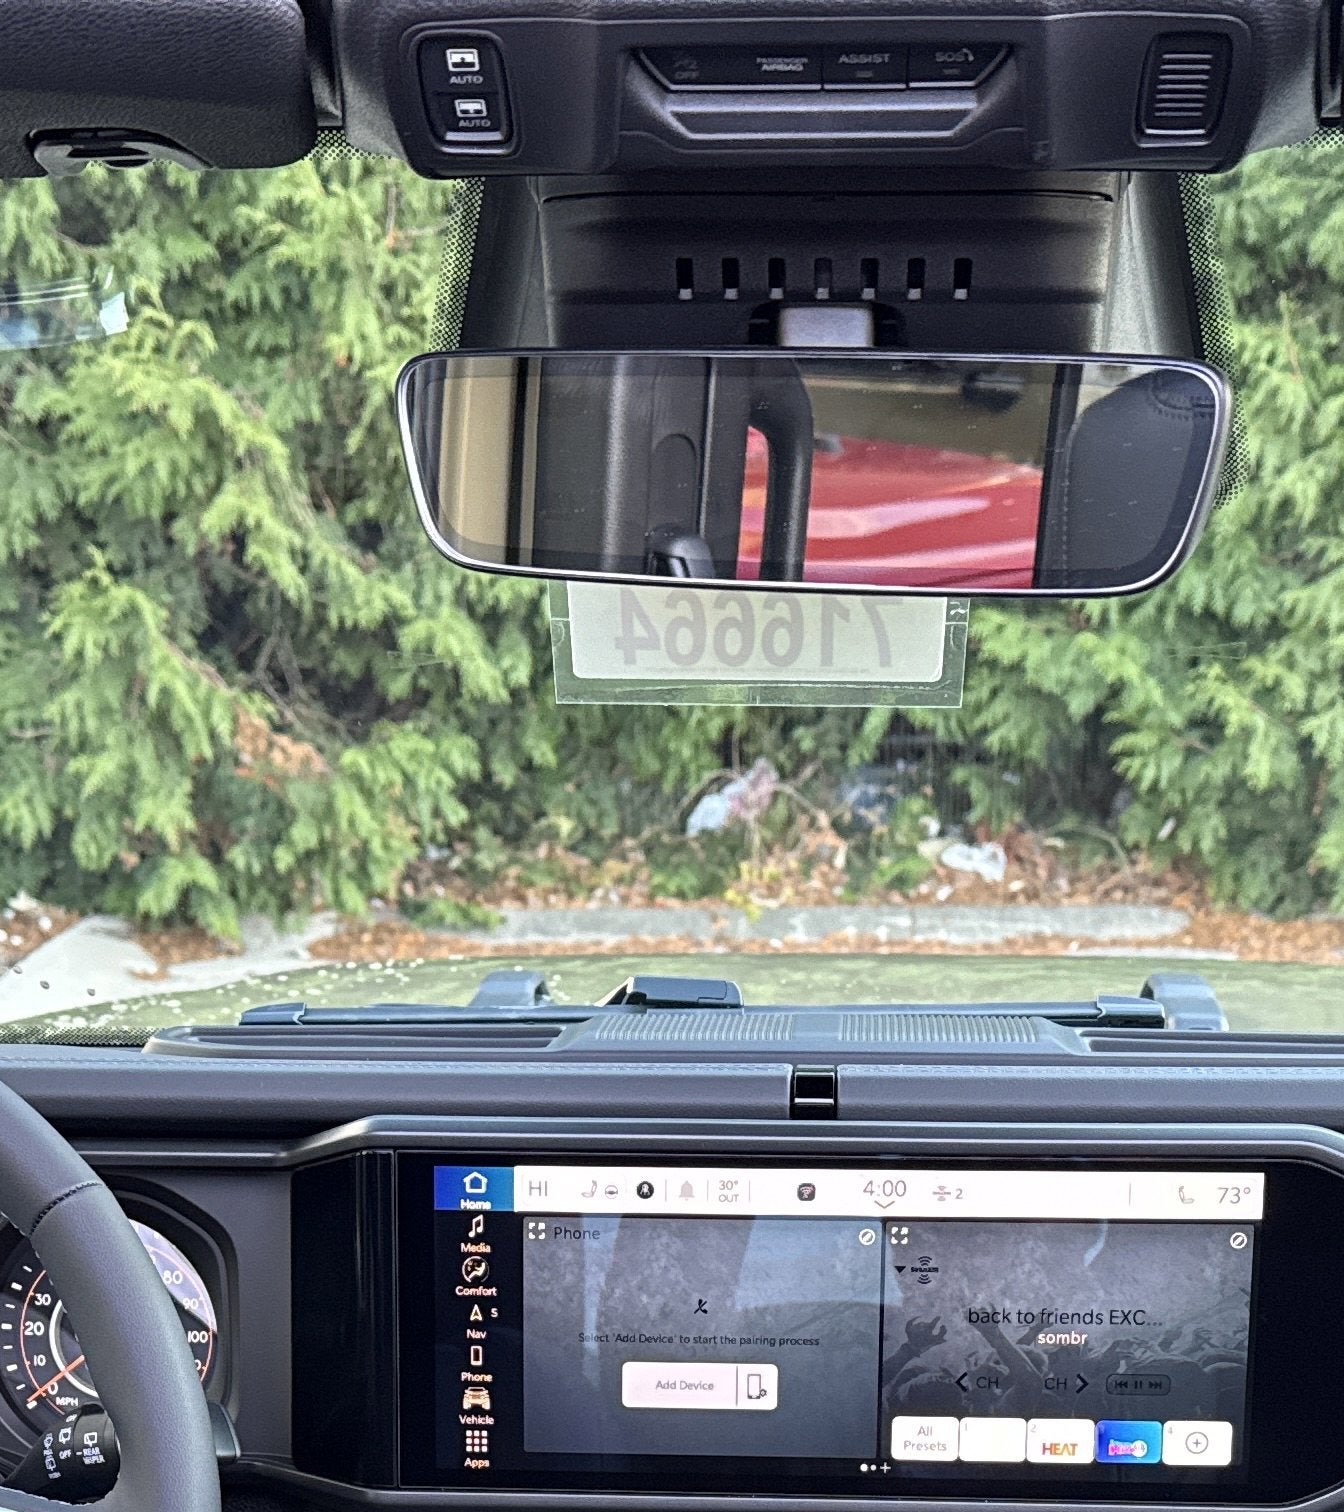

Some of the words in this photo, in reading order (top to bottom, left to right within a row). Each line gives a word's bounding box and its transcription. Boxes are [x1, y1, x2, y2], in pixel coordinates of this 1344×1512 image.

[838, 53, 890, 64] ASSIST
[935, 52, 964, 62] SOS
[450, 75, 484, 84] AUTO
[675, 71, 699, 79] OFF
[458, 119, 491, 127] AUTO
[529, 1181, 548, 1197] HI
[862, 1179, 907, 1198] 4:00
[718, 1193, 739, 1203] OUT
[1217, 1186, 1251, 1205] 73°
[460, 1199, 492, 1210] Home
[554, 1227, 601, 1240] Phone
[461, 1243, 491, 1253] Media
[163, 1270, 183, 1284] 80
[455, 1286, 497, 1297] Comfort
[34, 1293, 51, 1306] 30
[183, 1298, 199, 1309] 90
[491, 1308, 498, 1317] S
[968, 1308, 1011, 1324] back
[1017, 1311, 1035, 1324] to
[1040, 1308, 1104, 1325] friends
[24, 1322, 45, 1335] 20
[187, 1331, 208, 1342] 100
[467, 1329, 487, 1340] Nav
[578, 1332, 610, 1343] Select
[679, 1335, 690, 1344] to
[693, 1335, 718, 1345] start
[720, 1336, 736, 1345] the
[739, 1336, 776, 1348] pairing
[778, 1338, 819, 1348] process
[1038, 1332, 1088, 1345] sombr
[34, 1355, 46, 1366] 10
[461, 1372, 493, 1383] Phone
[976, 1376, 999, 1390] CH
[48, 1381, 58, 1395] 0
[655, 1380, 677, 1390] Add
[679, 1380, 714, 1391] Device
[1044, 1377, 1068, 1391] CH
[56, 1397, 78, 1406] MPH
[459, 1415, 494, 1425] Vehicle
[917, 1425, 933, 1437] All
[903, 1440, 947, 1451] Presets
[1042, 1443, 1078, 1456] HEAT
[464, 1458, 490, 1469] Apps
